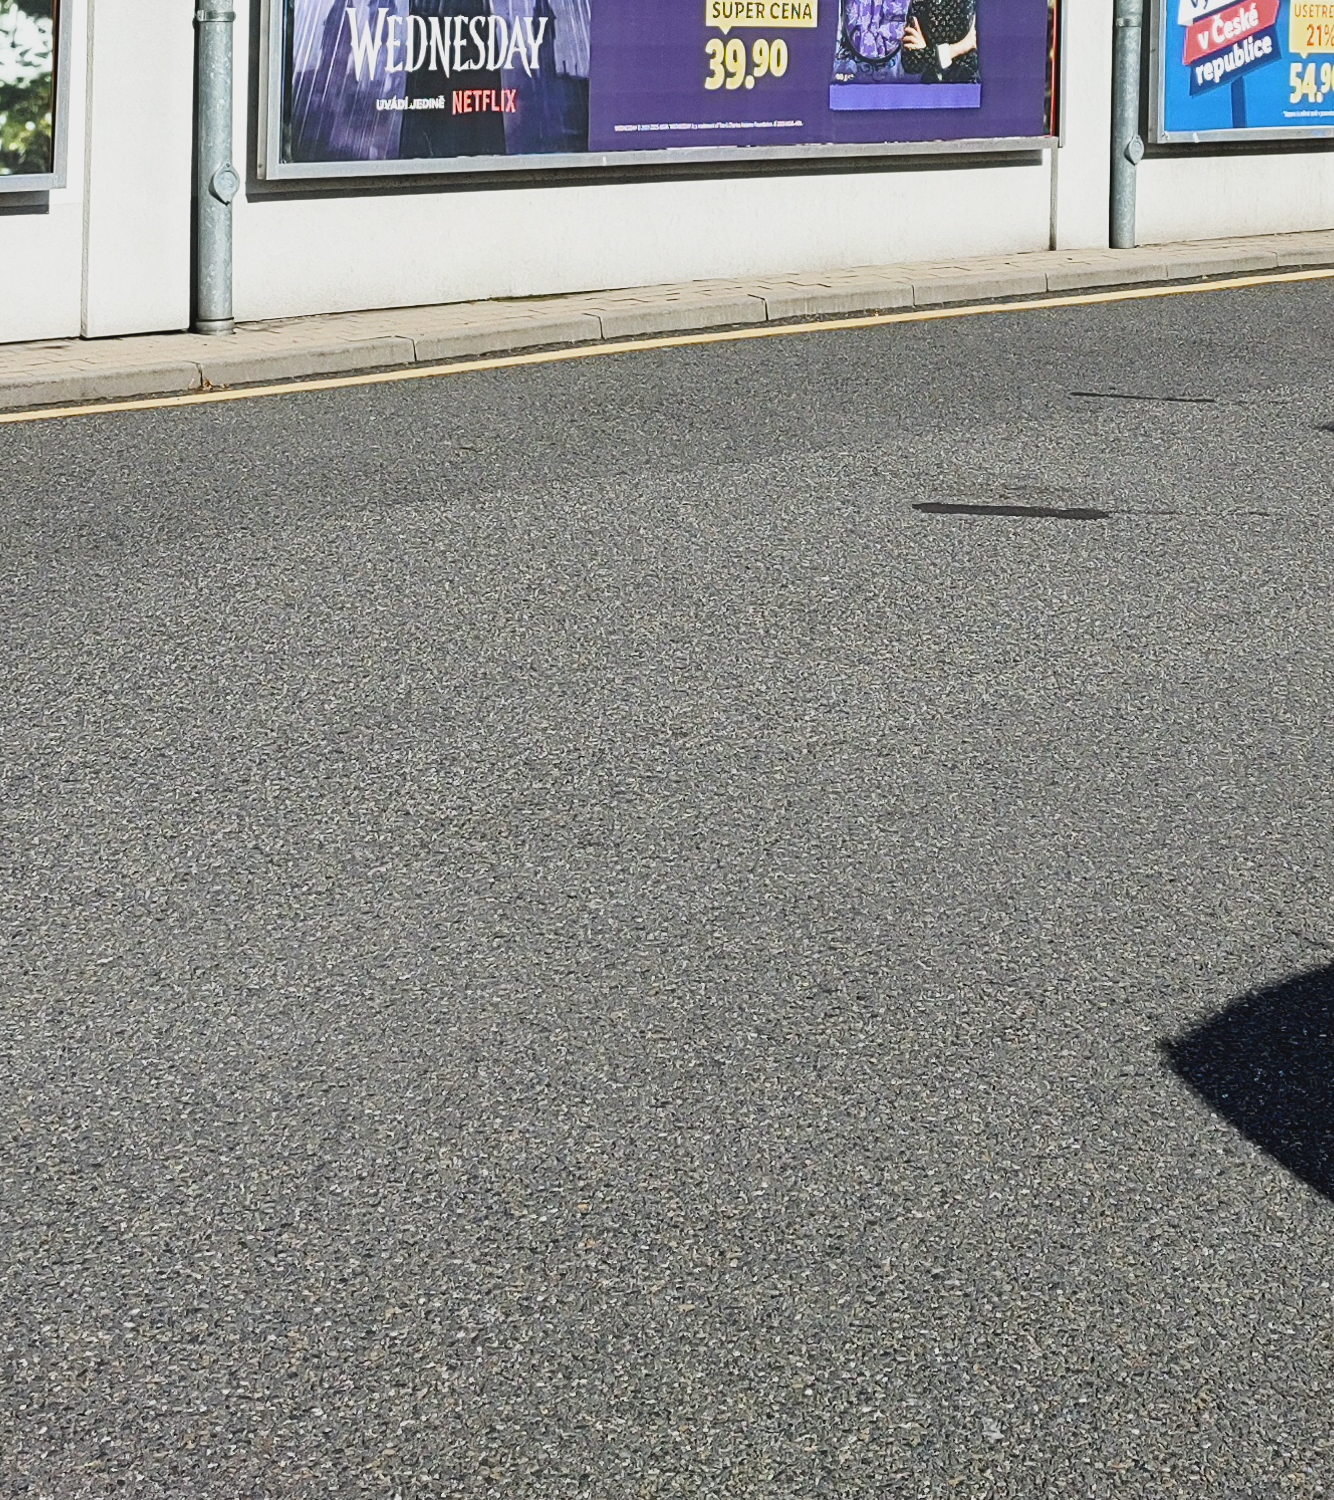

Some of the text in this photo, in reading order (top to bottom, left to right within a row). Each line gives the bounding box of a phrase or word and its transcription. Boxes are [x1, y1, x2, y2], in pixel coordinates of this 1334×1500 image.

[712, 1, 813, 20] SUPER CENA
[1197, 2, 1259, 51] v České
[346, 7, 549, 82] WEDNESDAY
[704, 38, 789, 91] 39.90
[1195, 35, 1273, 86] republice
[452, 88, 517, 116] NETFLIX
